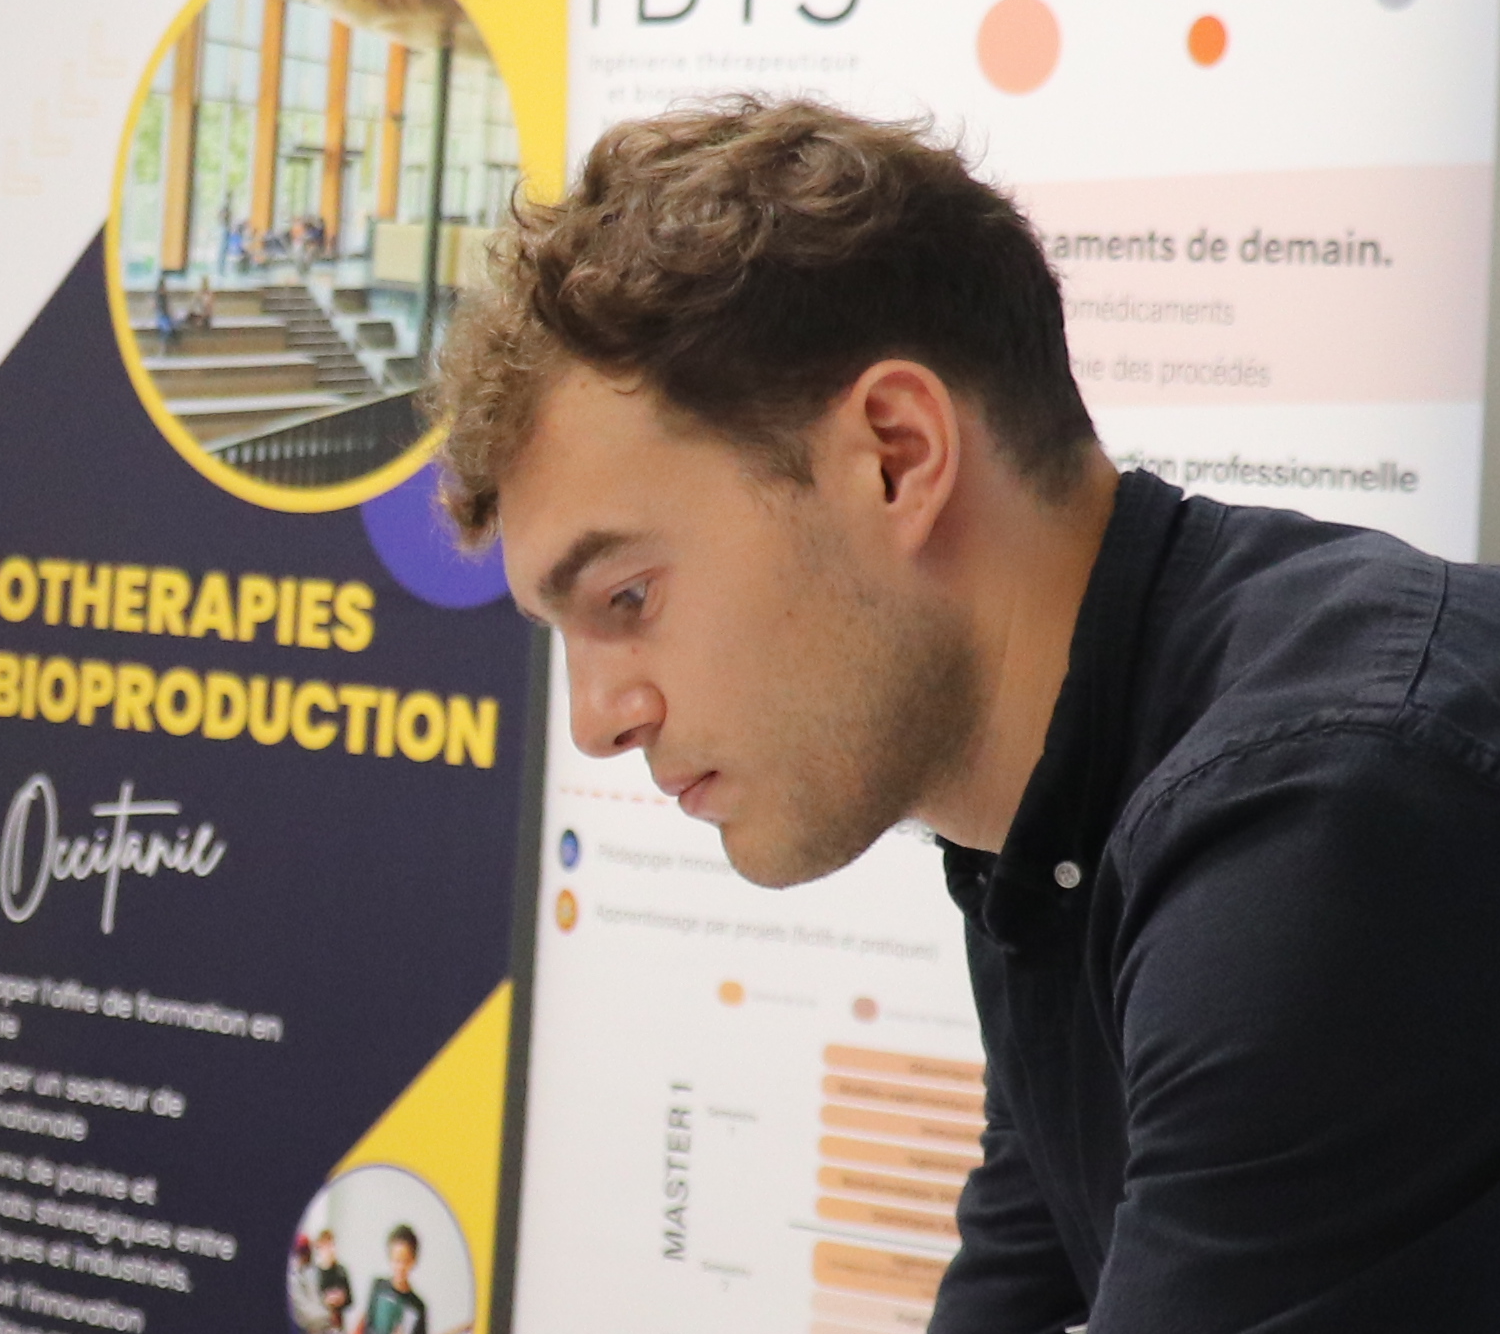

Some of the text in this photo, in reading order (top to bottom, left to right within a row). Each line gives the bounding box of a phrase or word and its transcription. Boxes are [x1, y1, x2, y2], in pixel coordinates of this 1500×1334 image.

[1042, 229, 1393, 268] aments de demain.
[1184, 450, 1419, 493] professionnelle
[40, 979, 98, 1014] l'offre
[101, 988, 131, 1019] de
[136, 993, 247, 1036] formation
[248, 1016, 283, 1042] en
[34, 1070, 60, 1099] un
[65, 1069, 148, 1114] secteur
[150, 1083, 184, 1120] de
[25, 1155, 54, 1187] de
[56, 1160, 128, 1200] pointe
[130, 1173, 157, 1204] et
[662, 1106, 692, 1262] MASTER
[45, 1239, 70, 1269] et
[172, 1219, 236, 1260] entre
[19, 1282, 145, 1334] l'innovation
